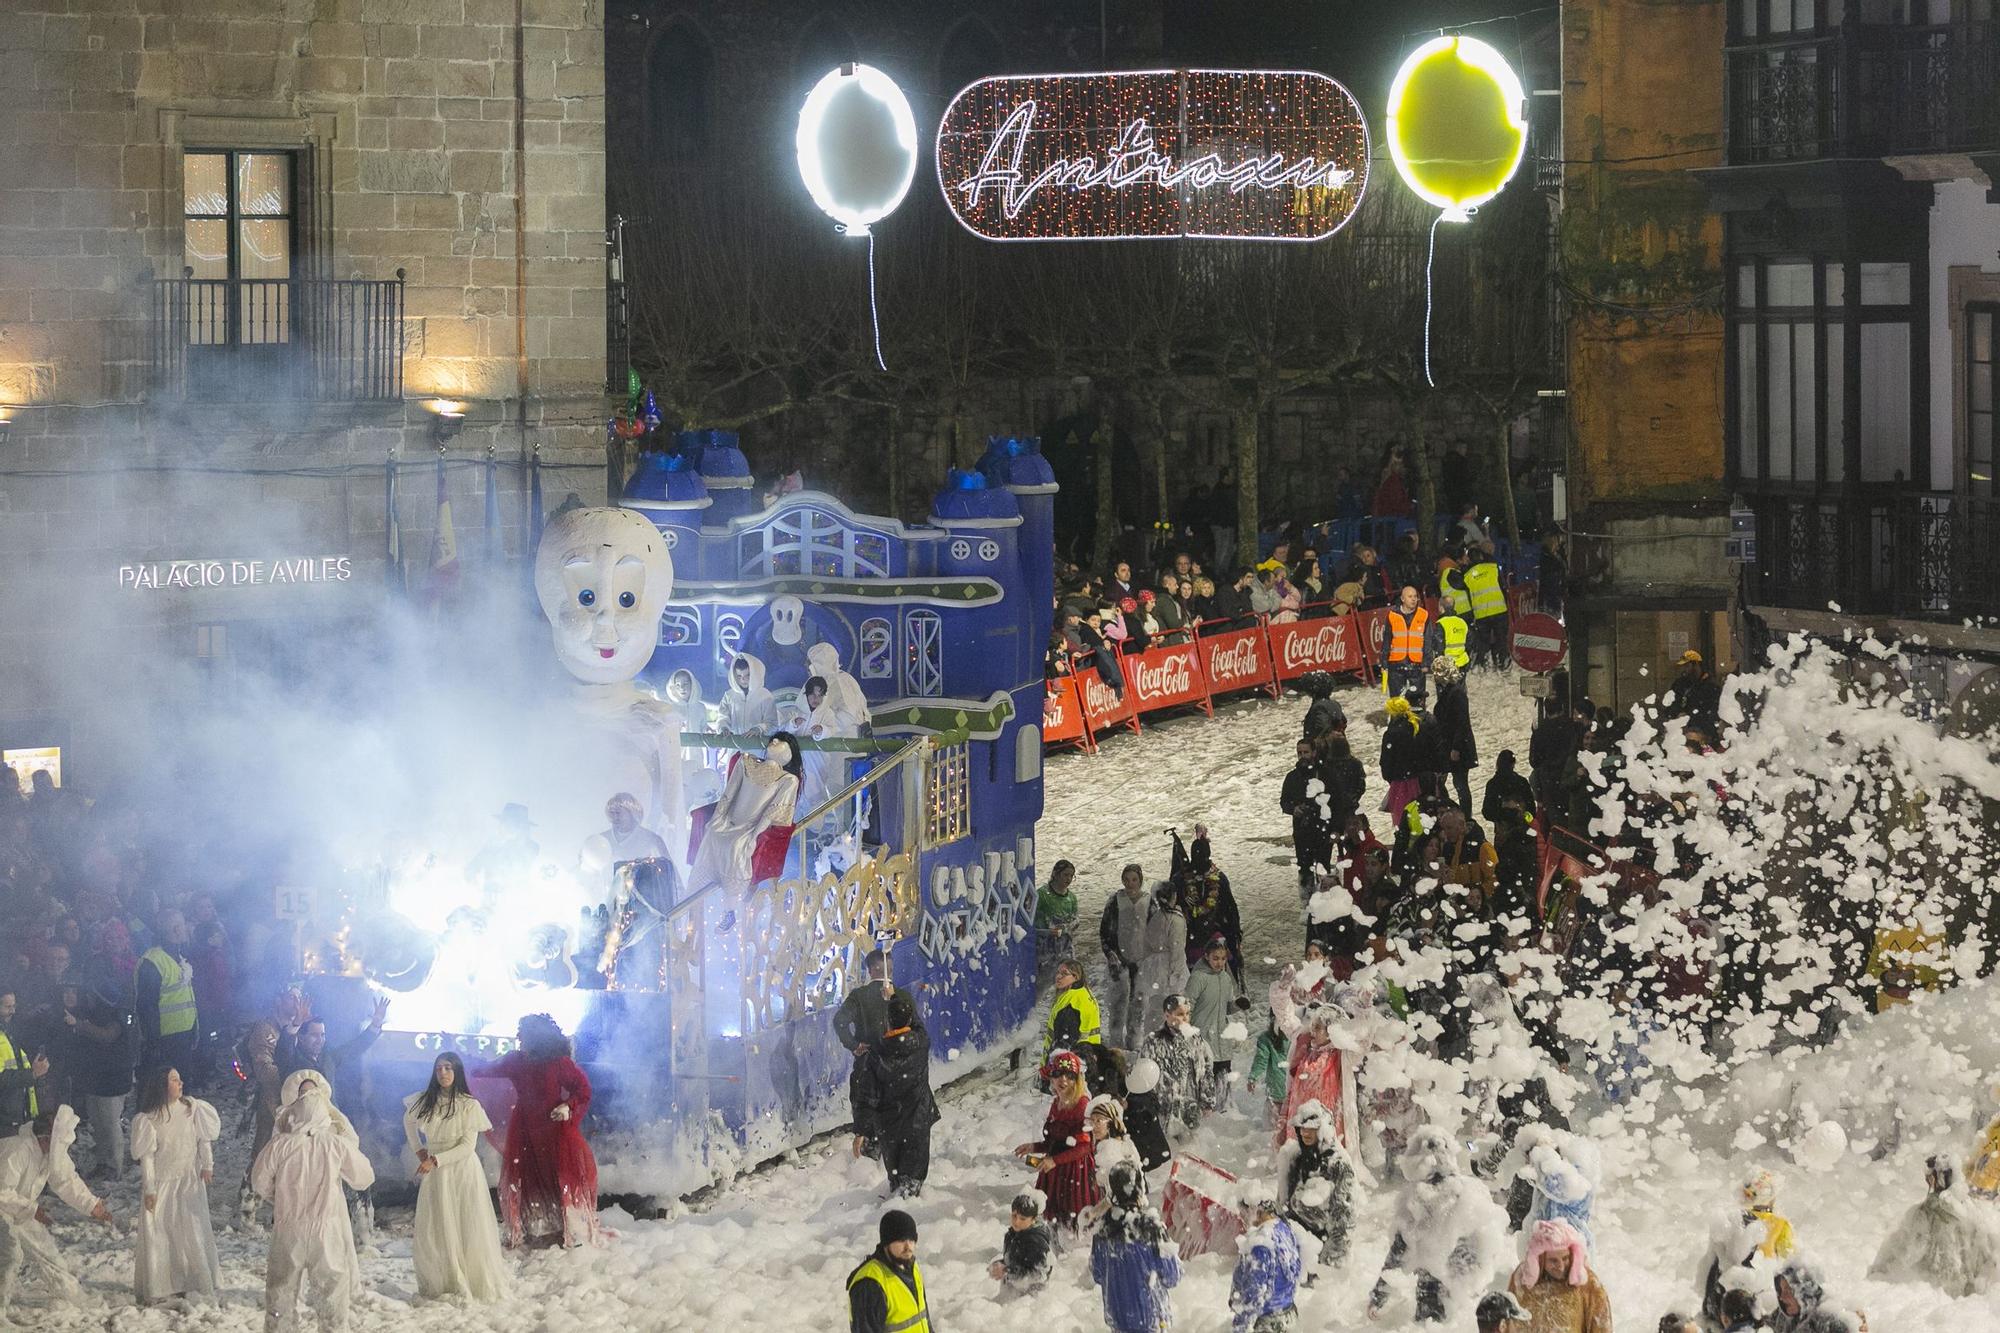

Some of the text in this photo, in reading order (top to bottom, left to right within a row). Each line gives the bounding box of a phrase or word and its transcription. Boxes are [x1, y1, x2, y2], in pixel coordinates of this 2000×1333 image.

[959, 100, 1353, 219] Antroxu
[119, 557, 352, 589] PALACIO DE AVILES
[1211, 637, 1257, 681] Coca-Cola
[1284, 625, 1346, 669] Coca-Cola
[1137, 654, 1189, 700] Coca-Cola
[281, 892, 311, 913] 15
